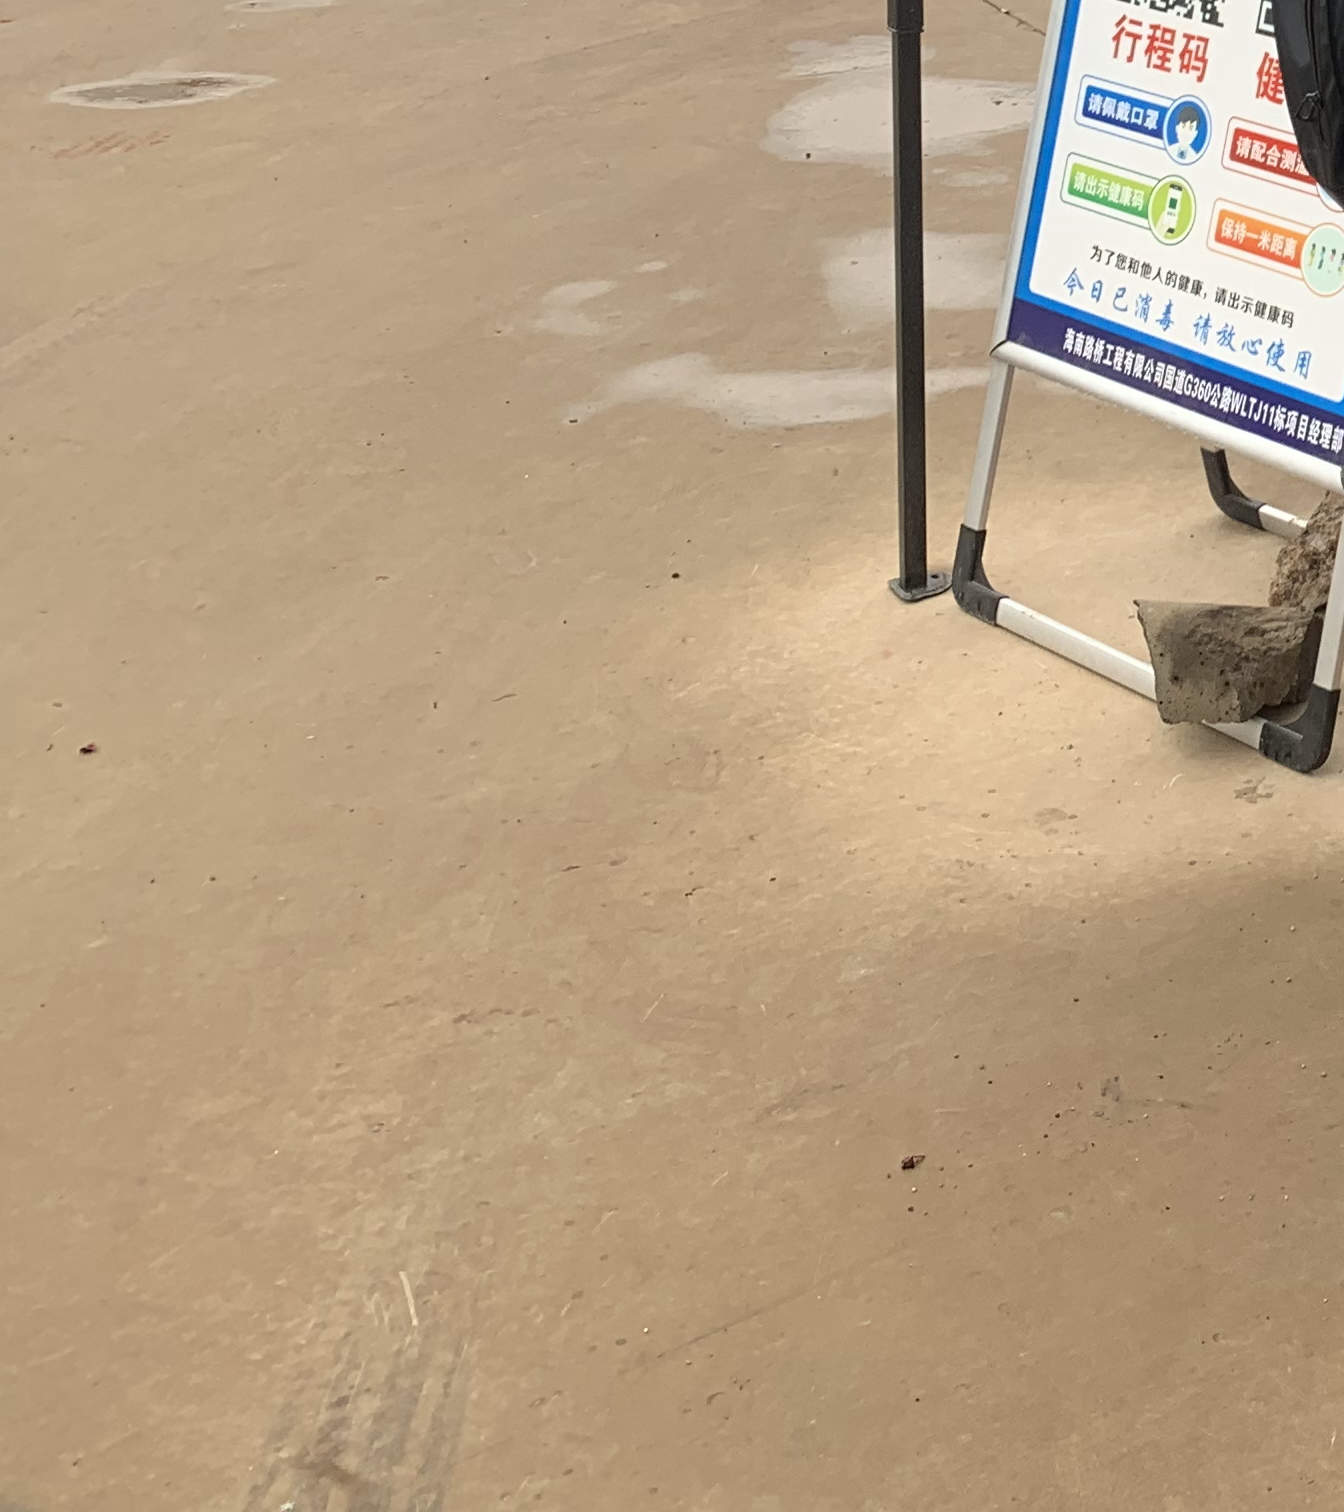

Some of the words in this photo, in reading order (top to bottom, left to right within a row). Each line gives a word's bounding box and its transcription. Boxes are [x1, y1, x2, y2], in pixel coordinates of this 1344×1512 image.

[1112, 14, 1210, 83] 行程码
[1088, 93, 1160, 131] 请佩戴口罩
[1073, 170, 1145, 212] 请出示健康码
[1221, 216, 1299, 262] 保持一米距离
